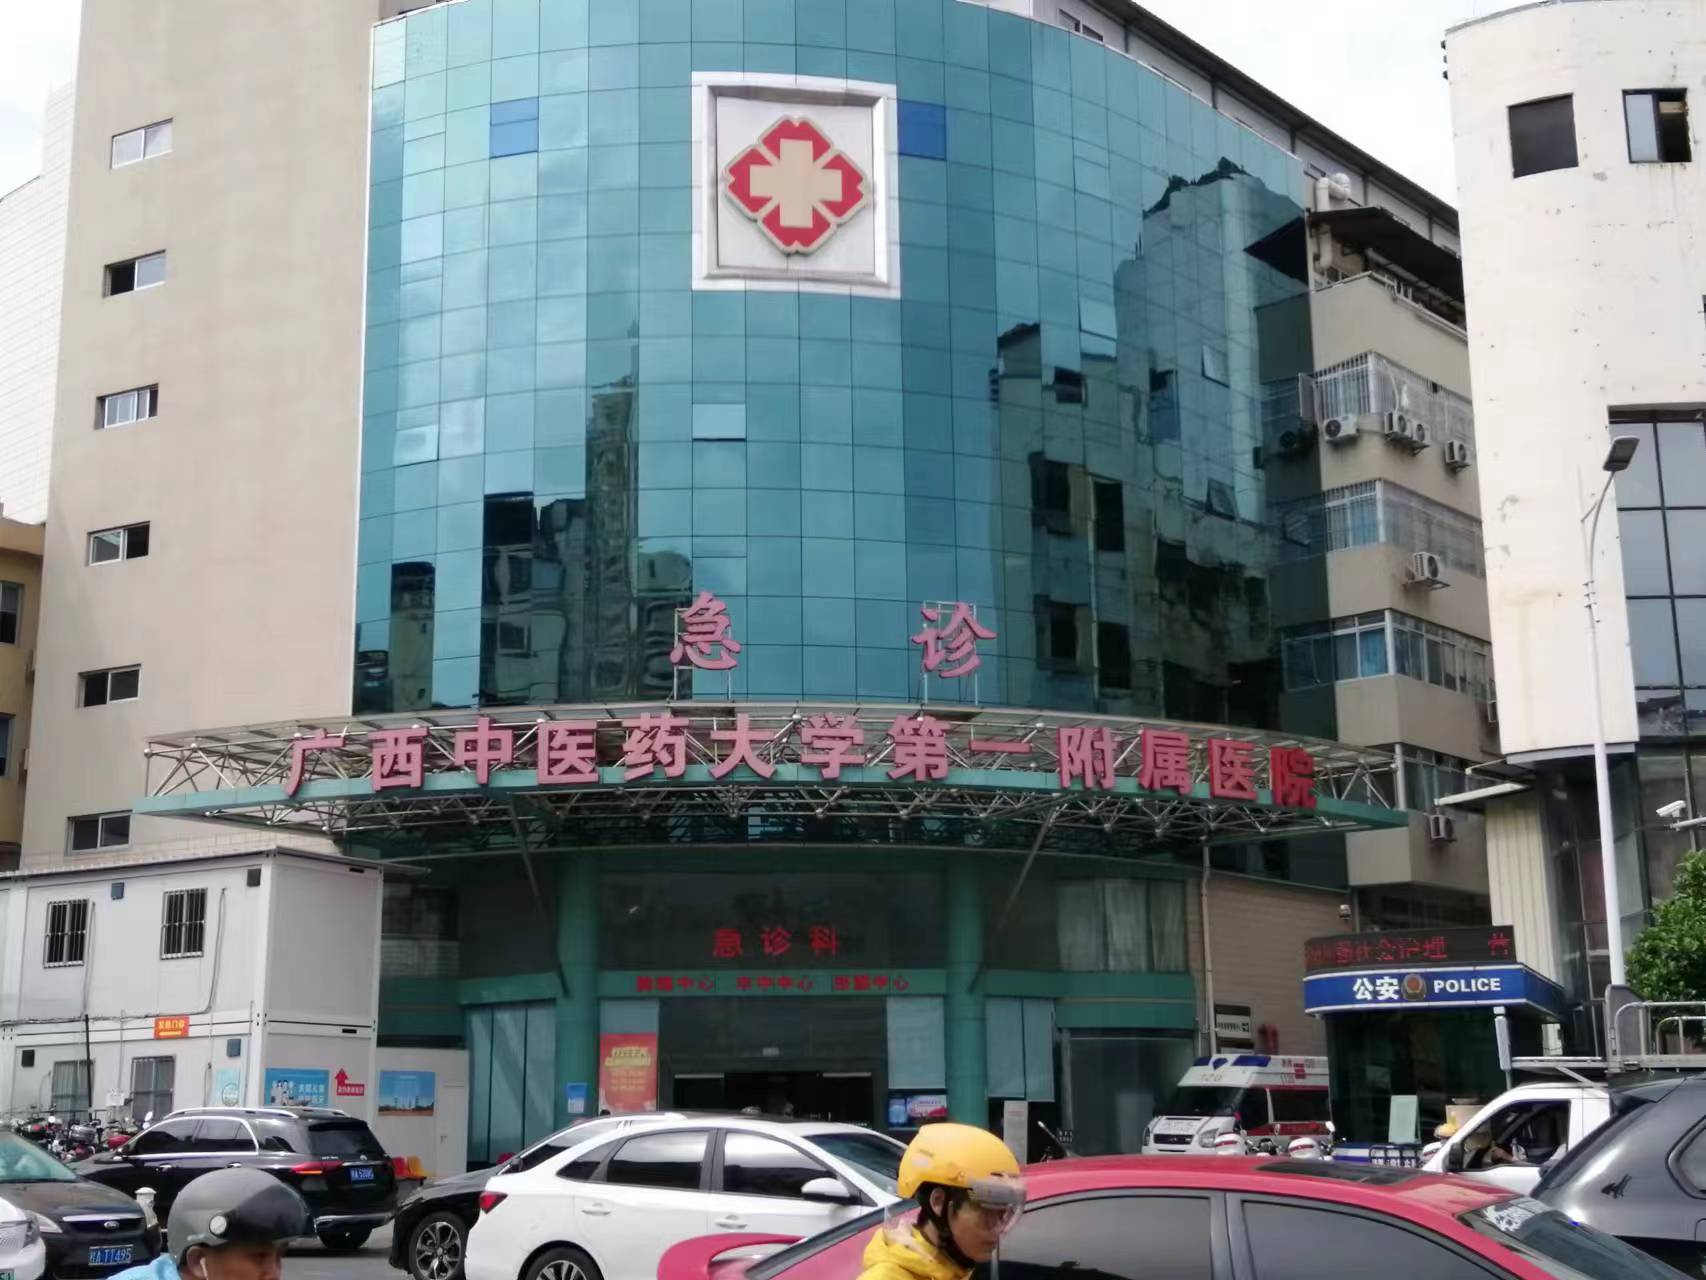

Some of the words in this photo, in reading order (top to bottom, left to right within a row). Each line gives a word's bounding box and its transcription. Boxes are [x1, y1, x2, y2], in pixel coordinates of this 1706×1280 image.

[670, 591, 998, 678] 急诊
[284, 711, 1318, 809] 广西中医药大学第一附属医院
[713, 927, 838, 958] 急诊科
[1353, 977, 1400, 1001] 公安
[1433, 977, 1502, 994] POLICE
